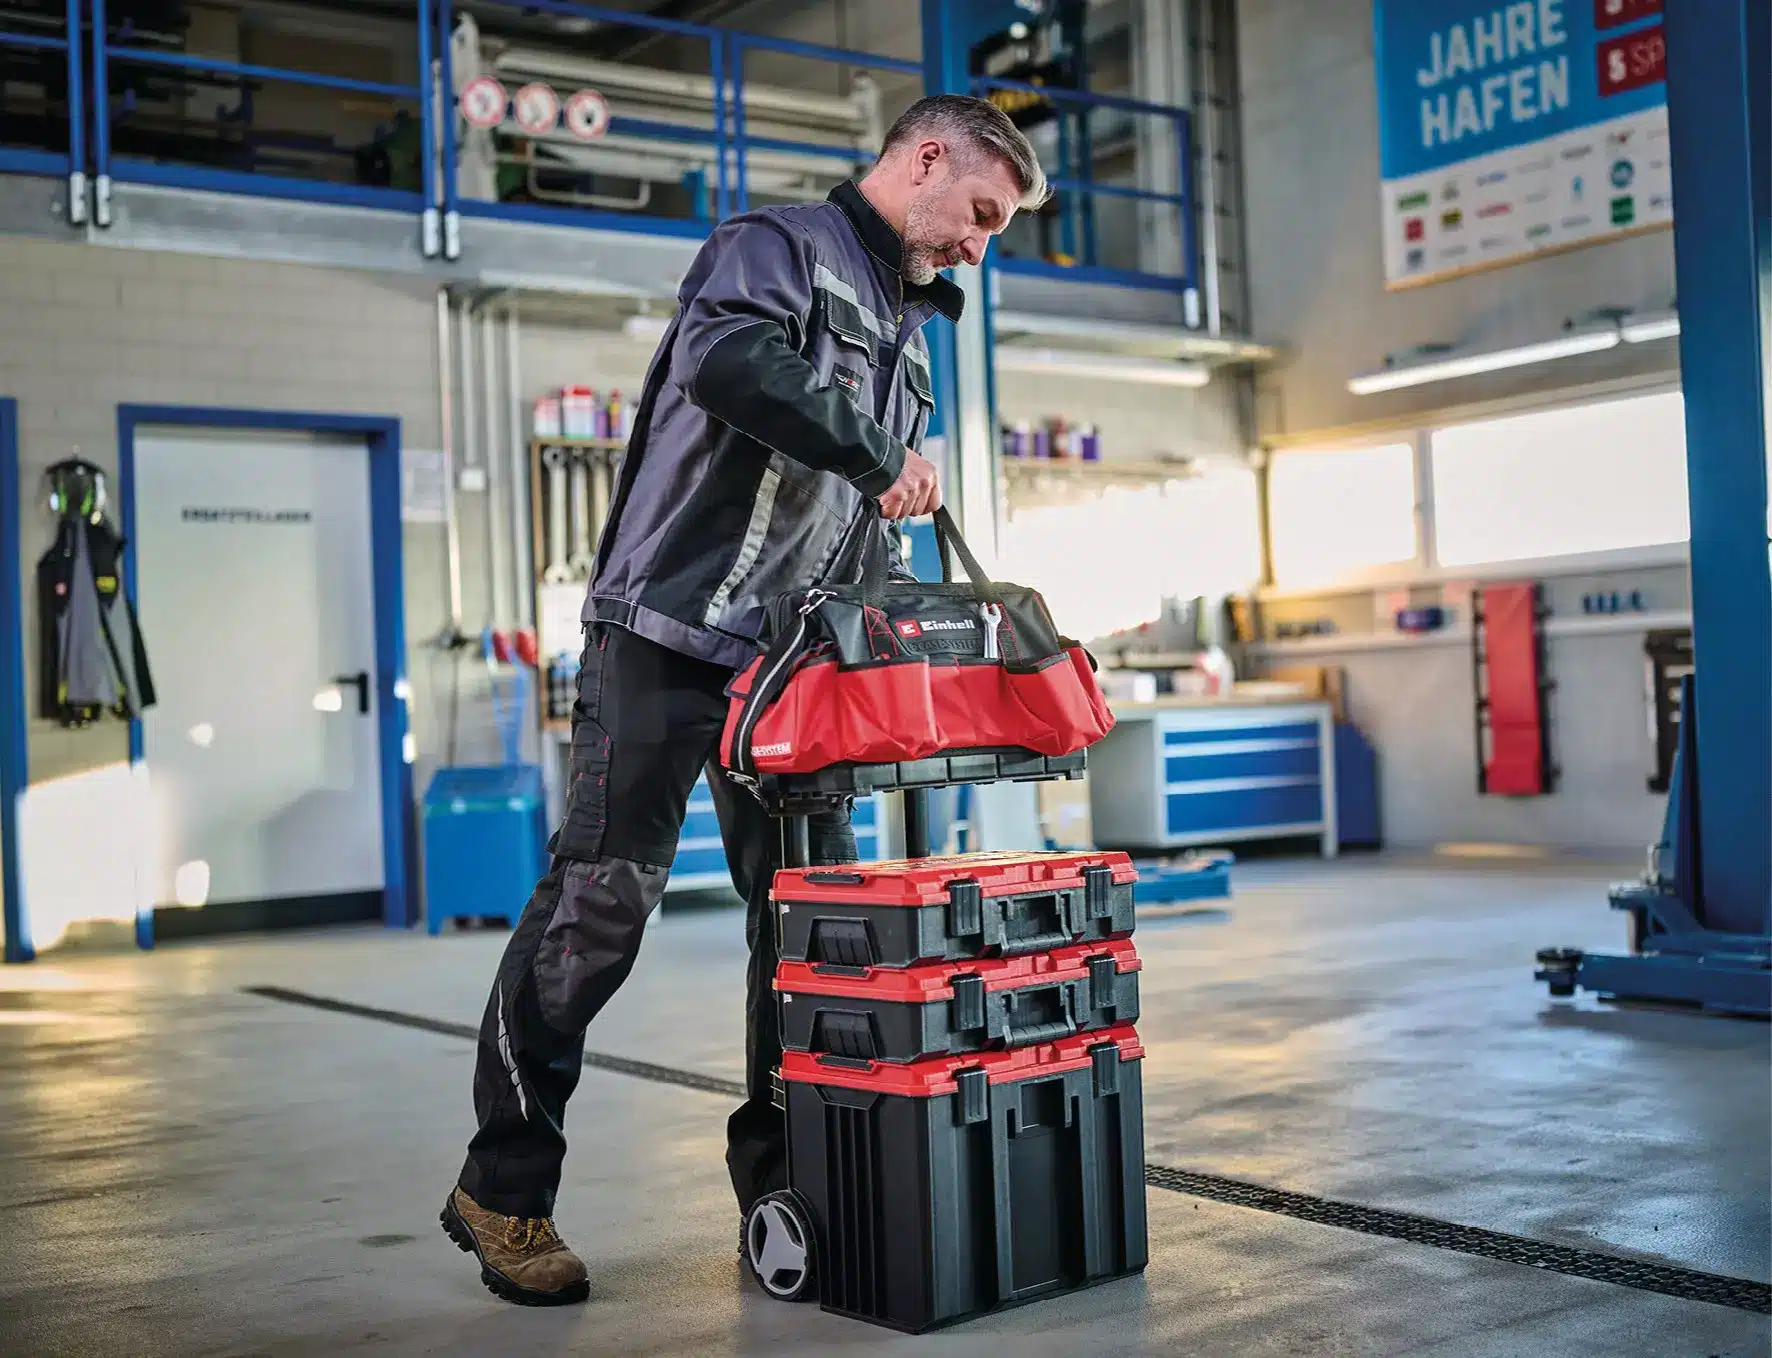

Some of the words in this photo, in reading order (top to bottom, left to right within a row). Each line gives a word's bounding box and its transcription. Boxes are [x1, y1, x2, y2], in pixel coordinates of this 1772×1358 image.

[1416, 0, 1568, 87] JAHRE
[1421, 55, 1570, 147] HAFEN
[919, 619, 977, 632] Einhell
